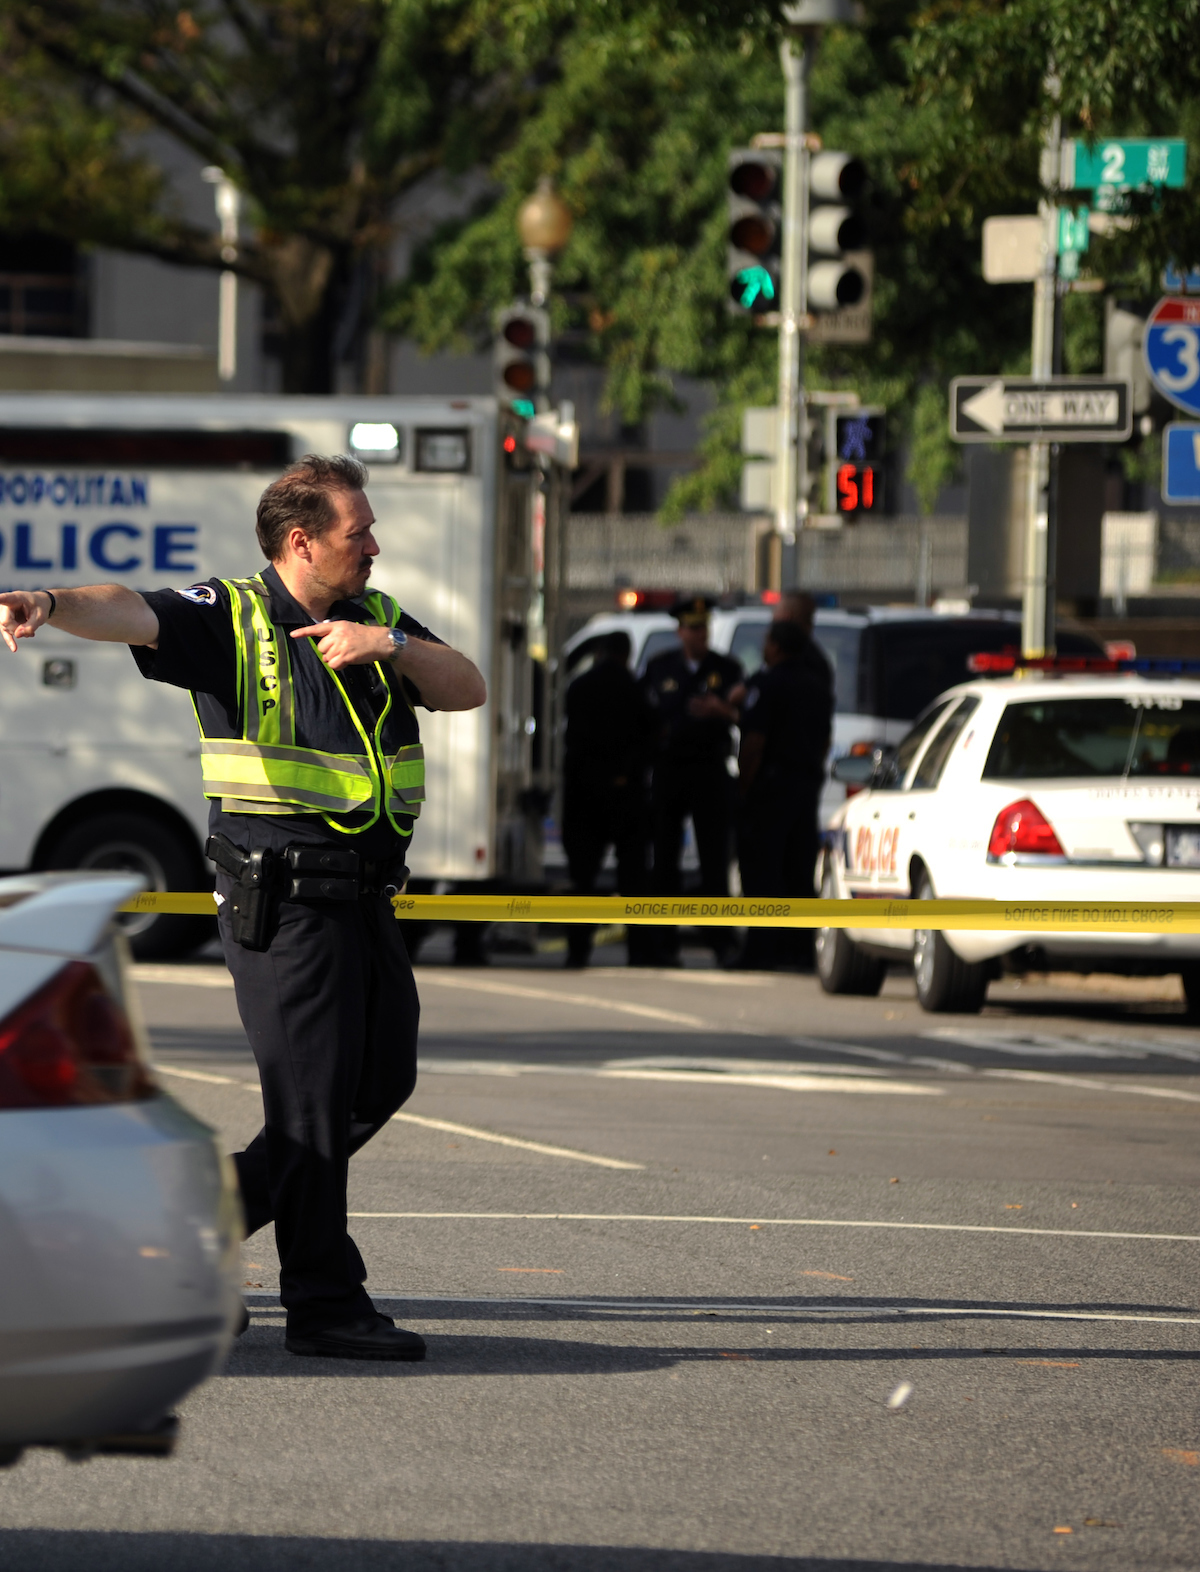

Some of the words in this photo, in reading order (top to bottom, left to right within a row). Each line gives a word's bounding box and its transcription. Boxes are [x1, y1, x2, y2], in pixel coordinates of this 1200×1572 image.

[1101, 143, 1125, 183] 2
[1006, 393, 1048, 421] ONE
[1062, 392, 1112, 421] WAY
[837, 463, 874, 511] 51
[256, 628, 278, 717] USCP
[855, 825, 900, 872] POLICE
